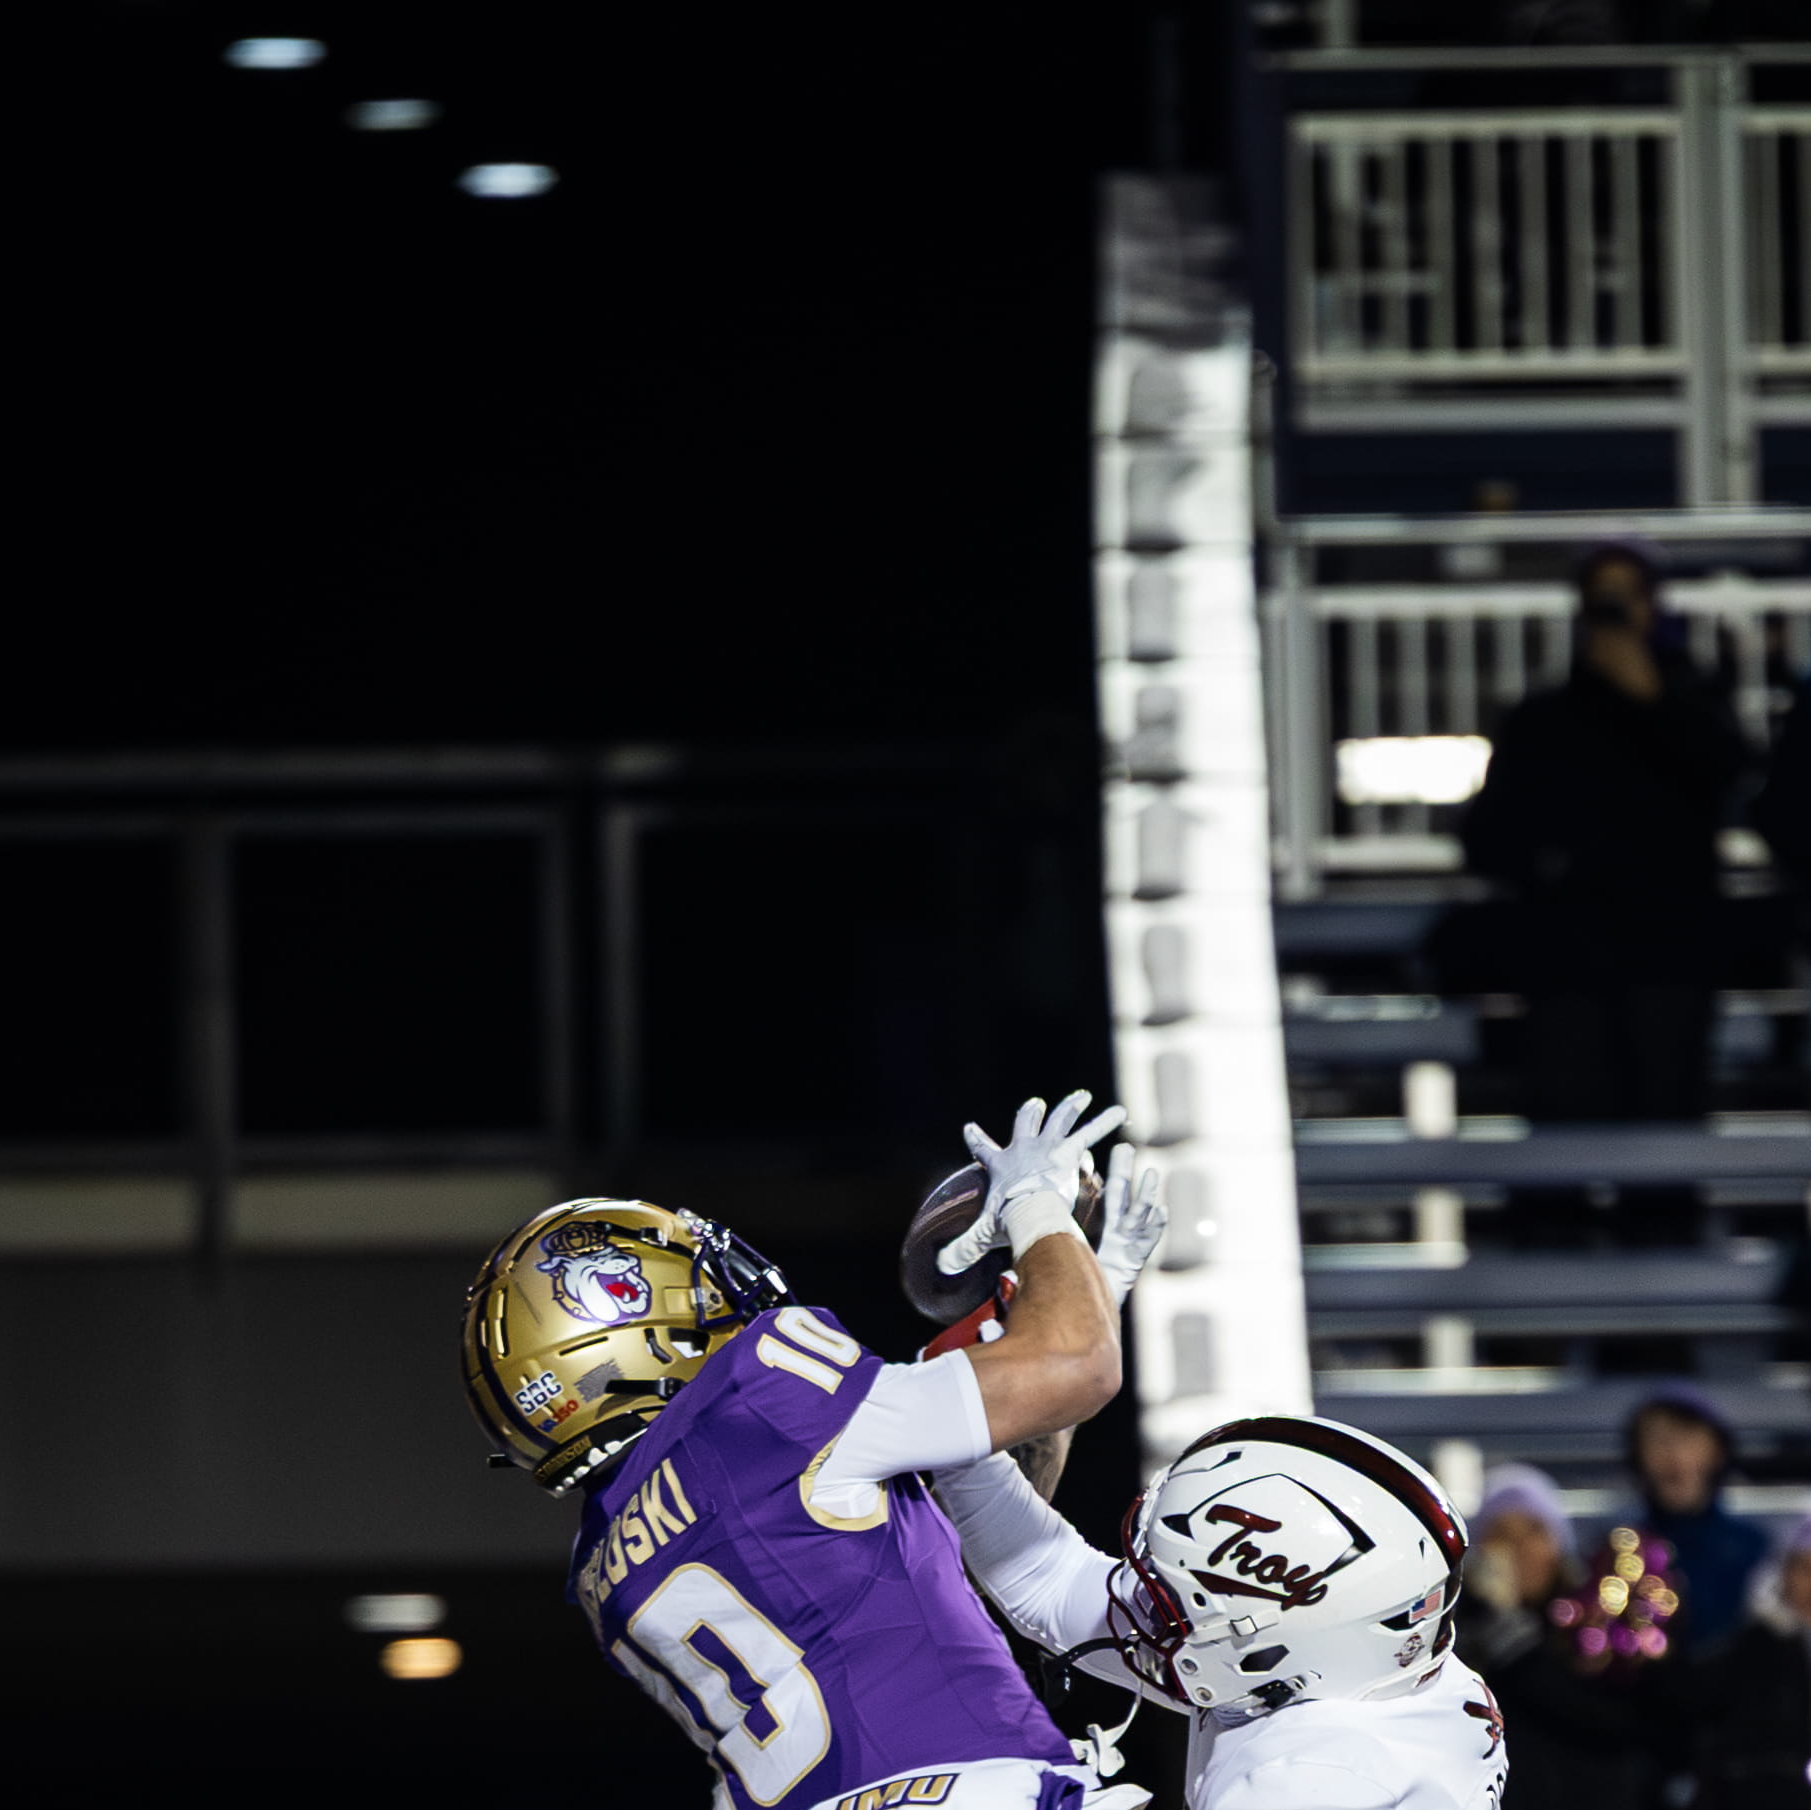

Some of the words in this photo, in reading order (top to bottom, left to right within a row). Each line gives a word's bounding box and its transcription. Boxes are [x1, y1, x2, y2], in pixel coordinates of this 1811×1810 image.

[515, 1372, 562, 1415] SBC
[756, 1306, 862, 1395] 10
[1202, 1503, 1328, 1611] Troy
